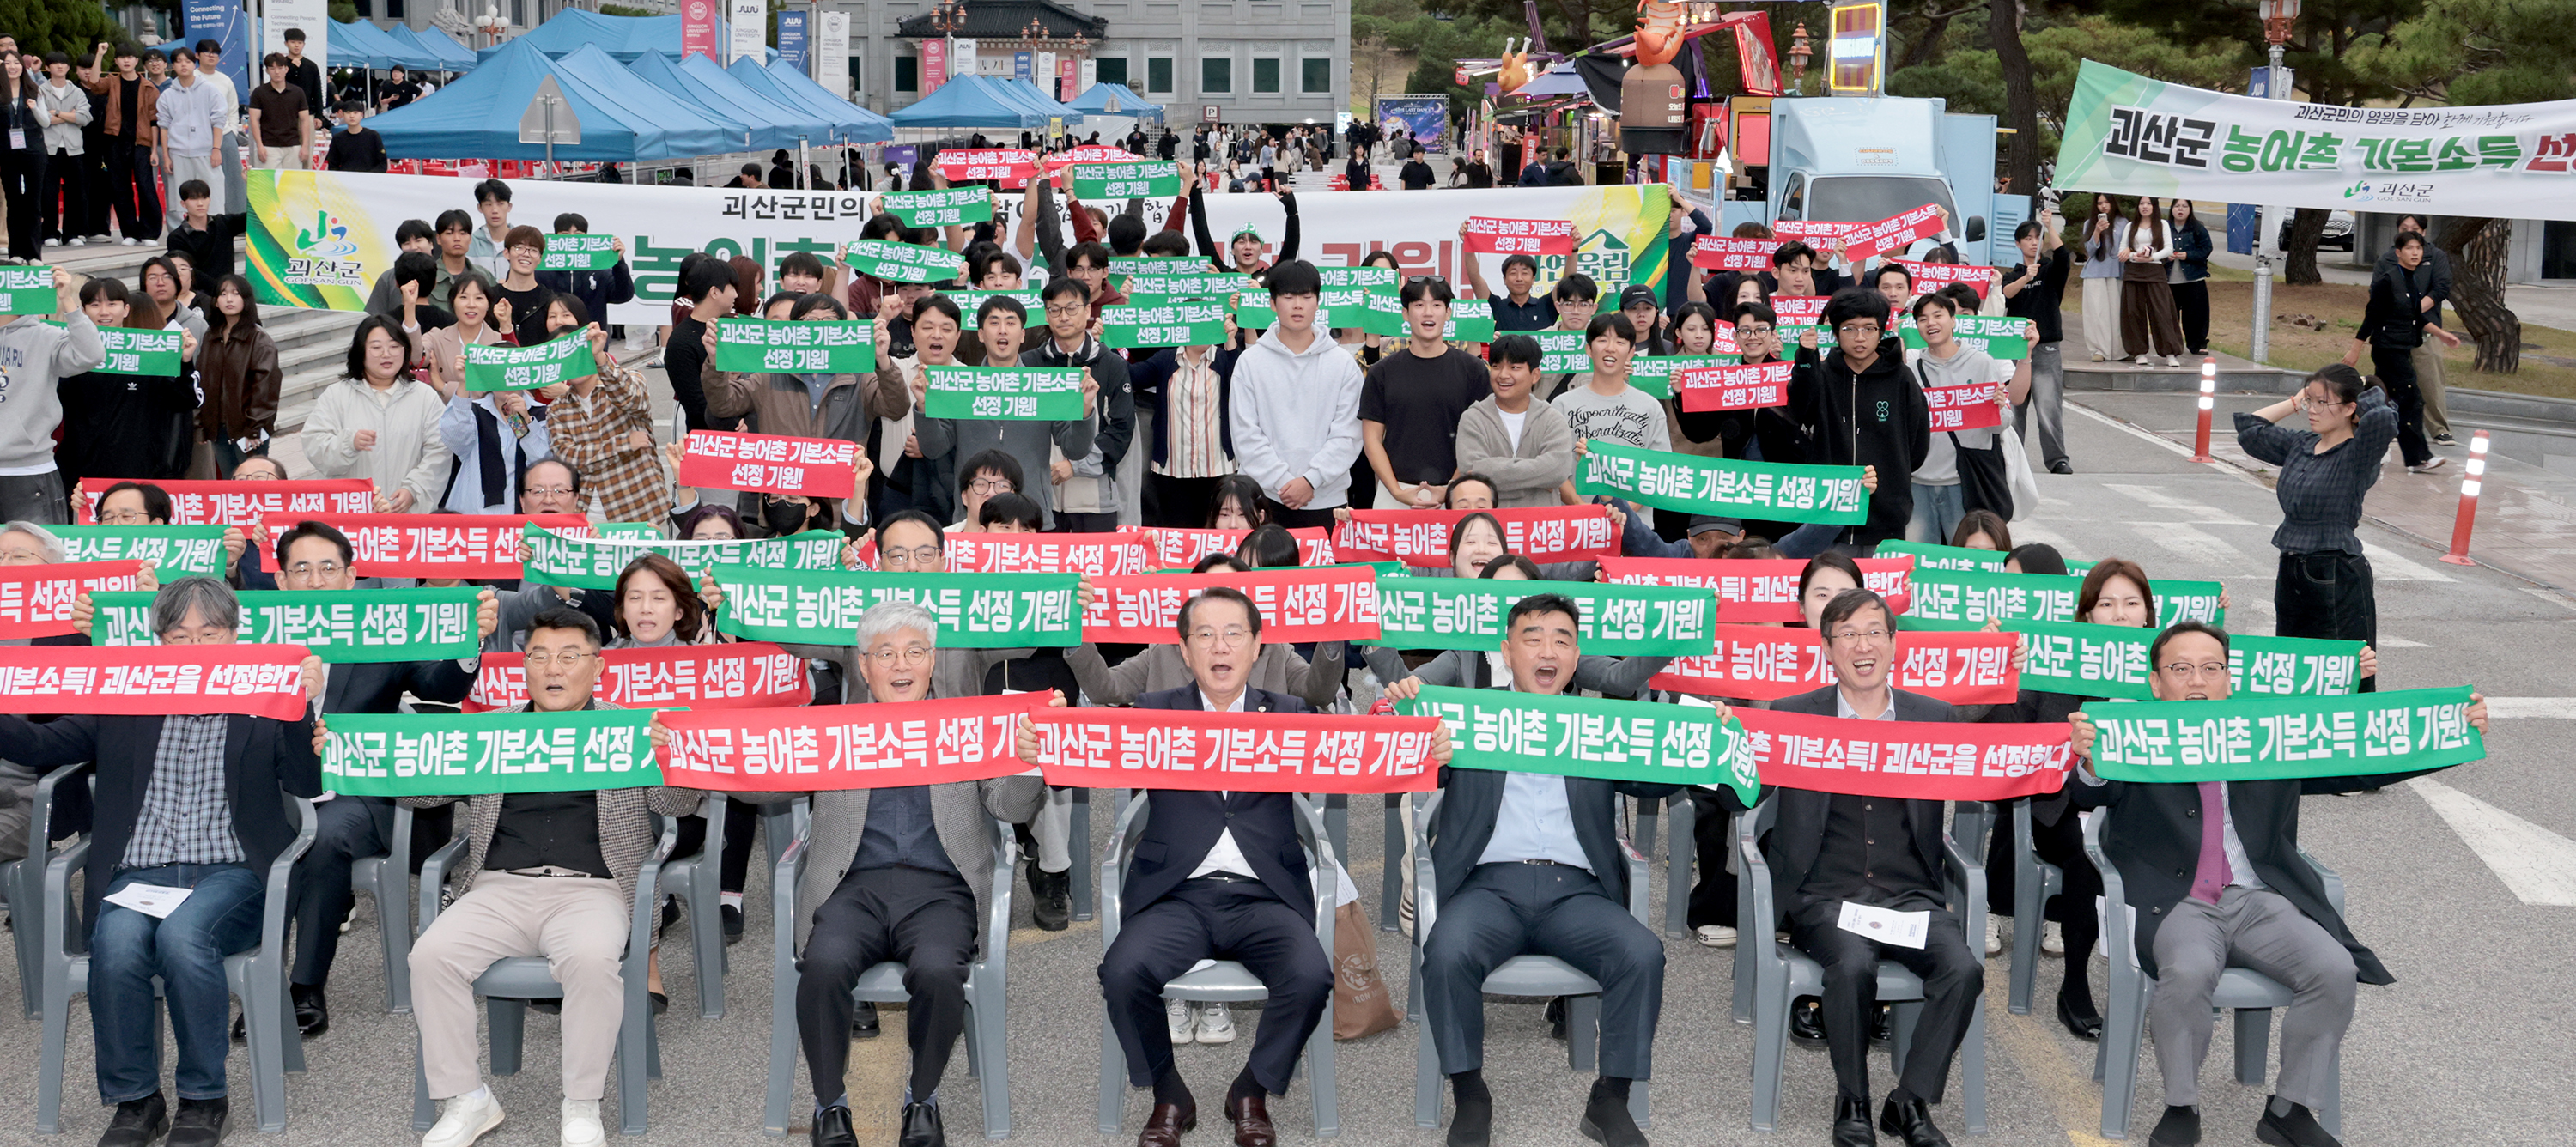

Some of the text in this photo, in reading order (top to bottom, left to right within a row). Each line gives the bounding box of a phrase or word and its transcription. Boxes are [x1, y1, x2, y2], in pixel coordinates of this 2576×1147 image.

[2294, 105, 2364, 124] 괴산군민의
[2366, 110, 2409, 125] 염원을
[2409, 112, 2440, 126] 담아
[2105, 108, 2576, 172] 괴산군 농어촌 기본소득 선
[936, 153, 966, 166] 괴산군
[968, 151, 998, 165] 농어촌
[966, 166, 1010, 179] 선정 기원!
[1075, 161, 1177, 179] 괴산군 농어촌 기본소득
[884, 186, 988, 209] 괴산군 농어촌 기본소득
[1105, 181, 1149, 196] 선정 기원!
[2379, 184, 2433, 197] 괴산군
[723, 194, 865, 222] 괴산군민의
[914, 209, 960, 225] 선정 기원!
[1467, 219, 1571, 235] 괴산군 농어촌 기본소득
[1844, 204, 1937, 247] 괴산군 농어촌 기본소득
[1495, 237, 1540, 252] 선정 기원!
[1875, 228, 1917, 252] 선정 기원!
[847, 240, 963, 270] 괴산군 농어촌 기본소득
[0, 271, 53, 288] 기본소득
[287, 259, 362, 278] 괴산군
[875, 262, 927, 282] 선정 기원!
[1102, 305, 1224, 325] 괴산군 농어촌 기본소득
[126, 333, 180, 352] 기본소득
[469, 327, 588, 364] 괴산군 농어촌 기본소득
[721, 324, 872, 345] 괴산군 농어촌 기본소득
[1137, 326, 1190, 343] 선정 기원!
[108, 353, 139, 371] 기원!
[764, 349, 829, 369] 선정 기원!
[505, 363, 562, 386] 선정 기원!
[930, 371, 1083, 392] 괴산군 농어촌 기본소득
[1685, 367, 1760, 388] 괴산군 농어촌
[972, 397, 1037, 416] 선정 기원!
[1722, 386, 1777, 406] 선정 기원!
[687, 434, 854, 465] 괴산군 농어촌 기본소득
[732, 464, 804, 489] 선정 기원!
[1585, 450, 1858, 512] 괴산군 농어촌 기본소득 선정 기원!
[1530, 517, 1611, 553] 선정 기원!
[721, 584, 1072, 632] 괴산군 농어촌 선정 기원!
[1601, 599, 1705, 640] 선정 기원!
[99, 665, 202, 695] 괴산군을
[608, 654, 800, 702] 기본소득 선정 기원!
[2251, 652, 2354, 695] 선정 기원!
[668, 716, 983, 774] 괴산군 농어촌 기본소득 선정
[2101, 703, 2470, 765] 괴산군 농어촌 기본소득 선정 기원!
[319, 726, 634, 777] 괴산군 농어촌 기본소득 선정
[1037, 723, 1432, 776] 괴산군 농어촌 기본소득 선정 기원!
[1473, 705, 1753, 788] 농어촌 기본소득 선정 기원!
[1779, 735, 2071, 777] 기본소득! 괴산군을 선정한다
[1352, 992, 1371, 1004] IRON
